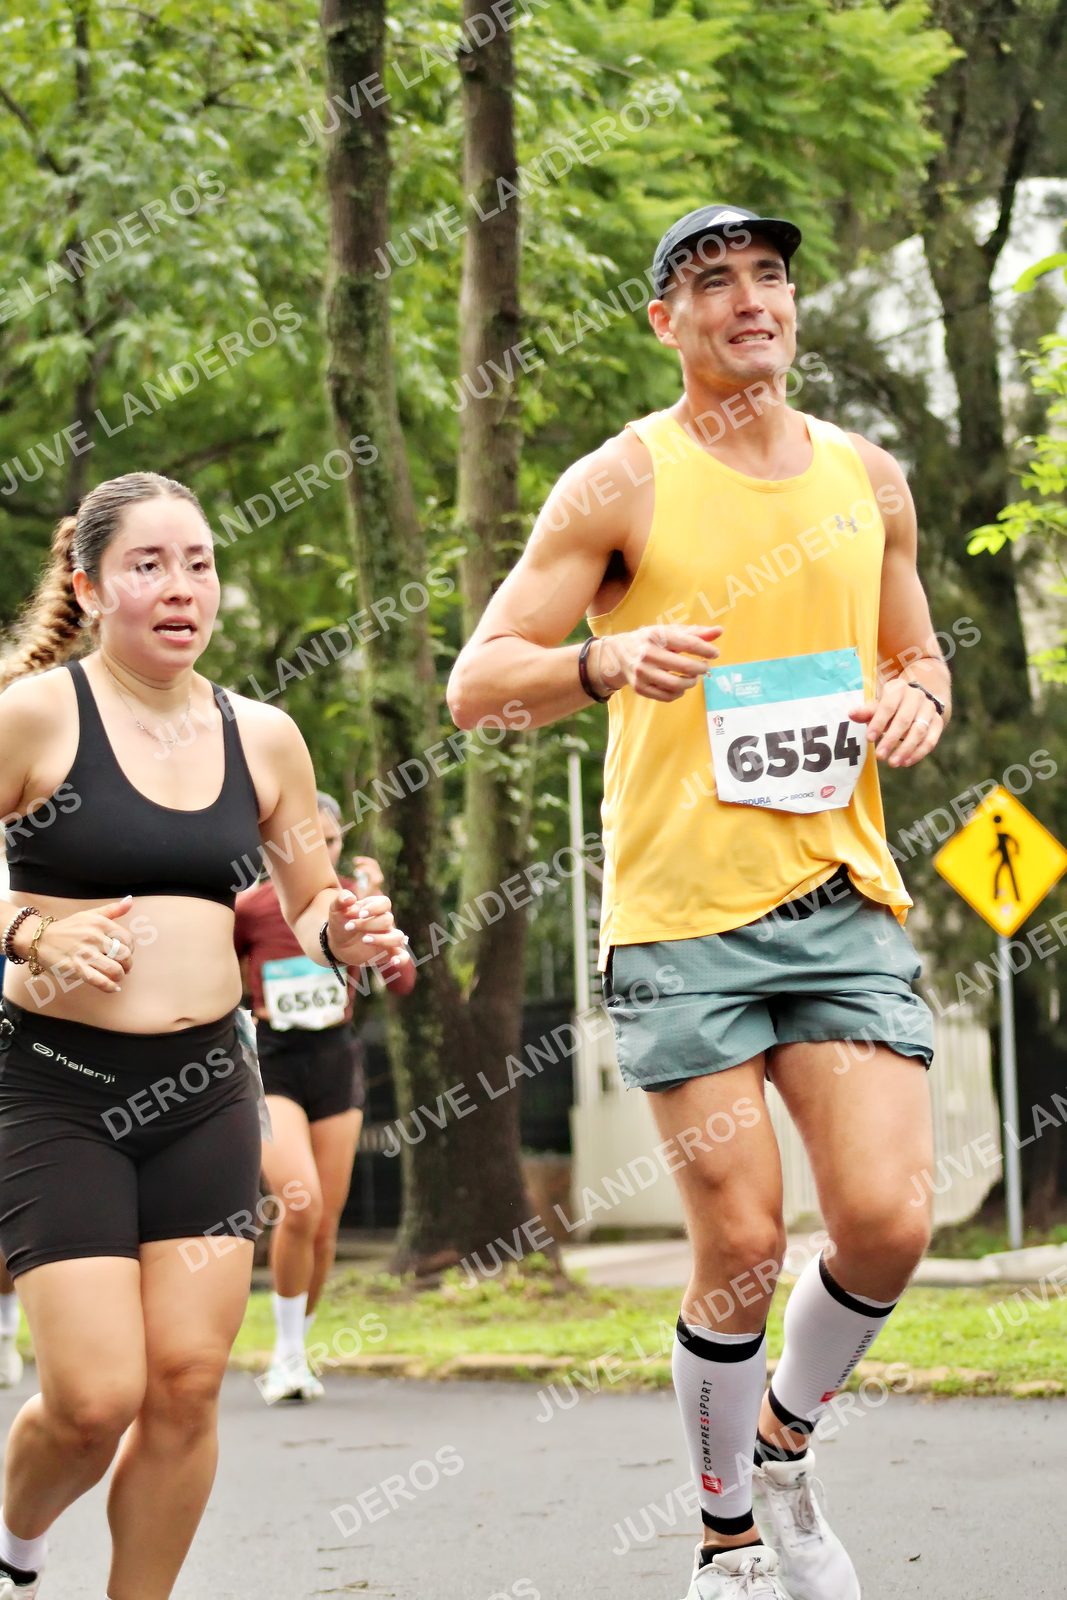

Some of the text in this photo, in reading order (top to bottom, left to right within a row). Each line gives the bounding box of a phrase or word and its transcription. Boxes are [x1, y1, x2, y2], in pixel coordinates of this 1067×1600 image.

[726, 720, 861, 783] 6554
[790, 791, 815, 801] BROOKS
[277, 986, 344, 1014] 6562
[56, 1053, 116, 1084] Kalenji
[699, 1379, 713, 1472] COMPRESSPORT
